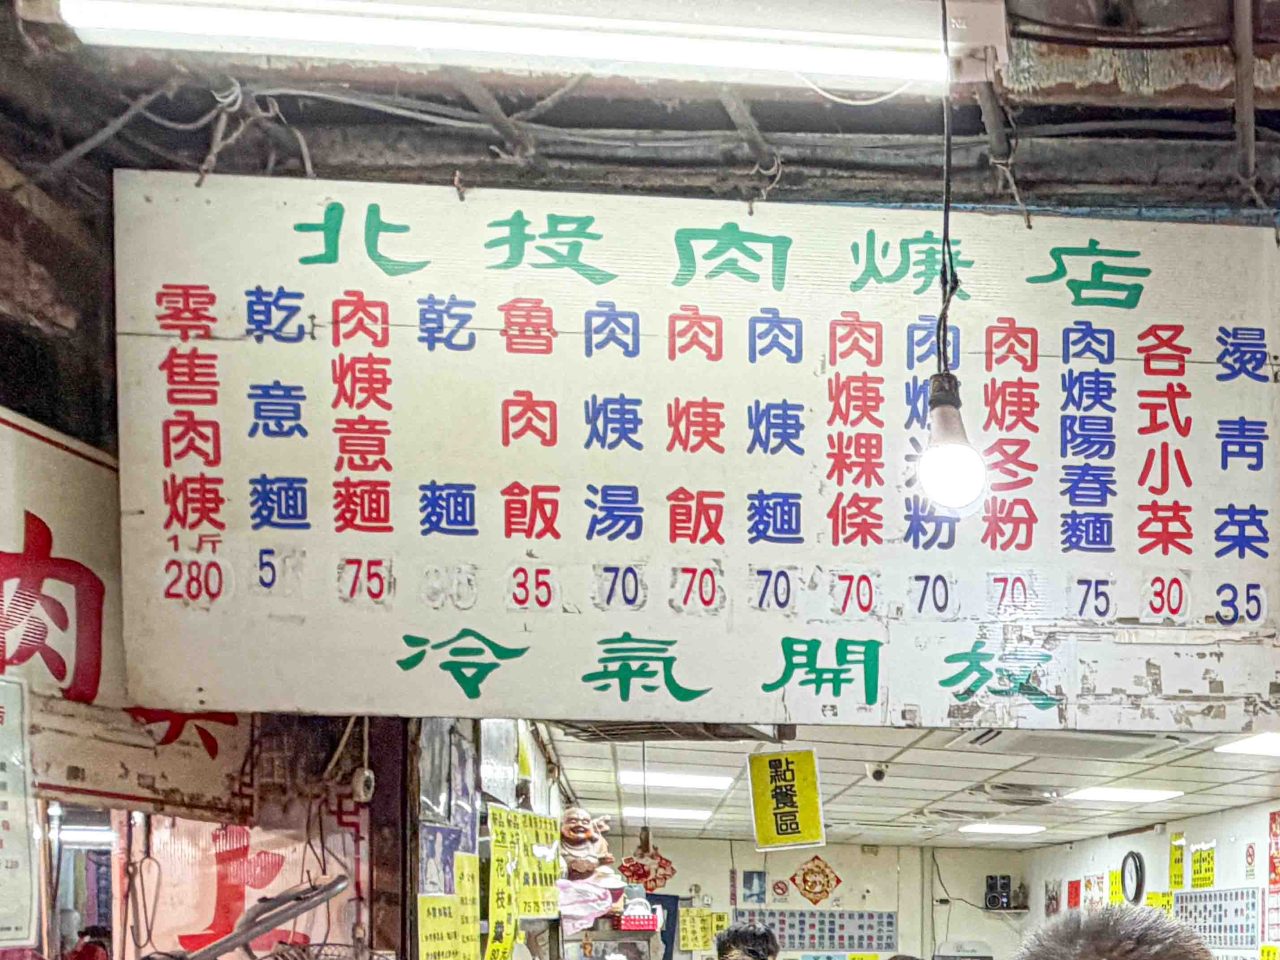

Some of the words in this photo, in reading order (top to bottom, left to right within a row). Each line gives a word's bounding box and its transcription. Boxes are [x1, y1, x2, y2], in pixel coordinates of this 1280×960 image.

[154, 283, 227, 531] 零售肉焿
[244, 285, 312, 531] 乾意麵
[330, 289, 395, 534] 肉焿意麵
[416, 293, 478, 537] 乾麵
[496, 297, 561, 540] 魯肉飯
[583, 300, 645, 542] 肉焿湯
[666, 303, 725, 545] 肉焿飯
[746, 306, 805, 545] 肉焿麵
[825, 310, 885, 548] 肉焿粿條
[980, 316, 1041, 551] 肉焿冬粉
[1058, 320, 1117, 554] 肉焿陽春麵
[1136, 323, 1194, 557] 各式小菜
[1213, 326, 1271, 560] 燙青菜
[163, 558, 224, 601] 280
[166, 533, 223, 554] 1斤
[344, 559, 385, 600] 75
[511, 567, 552, 608] 35
[602, 566, 639, 606] 70
[681, 567, 717, 608] 70
[756, 569, 792, 608] 70
[837, 572, 873, 613] 70
[913, 573, 949, 614] 70
[991, 576, 1027, 616] 70
[1075, 578, 1110, 617] 75
[1148, 576, 1184, 615] 30
[1214, 582, 1263, 626] 35
[395, 626, 1064, 710] 冷氣開放
[768, 757, 802, 837] 點餐區
